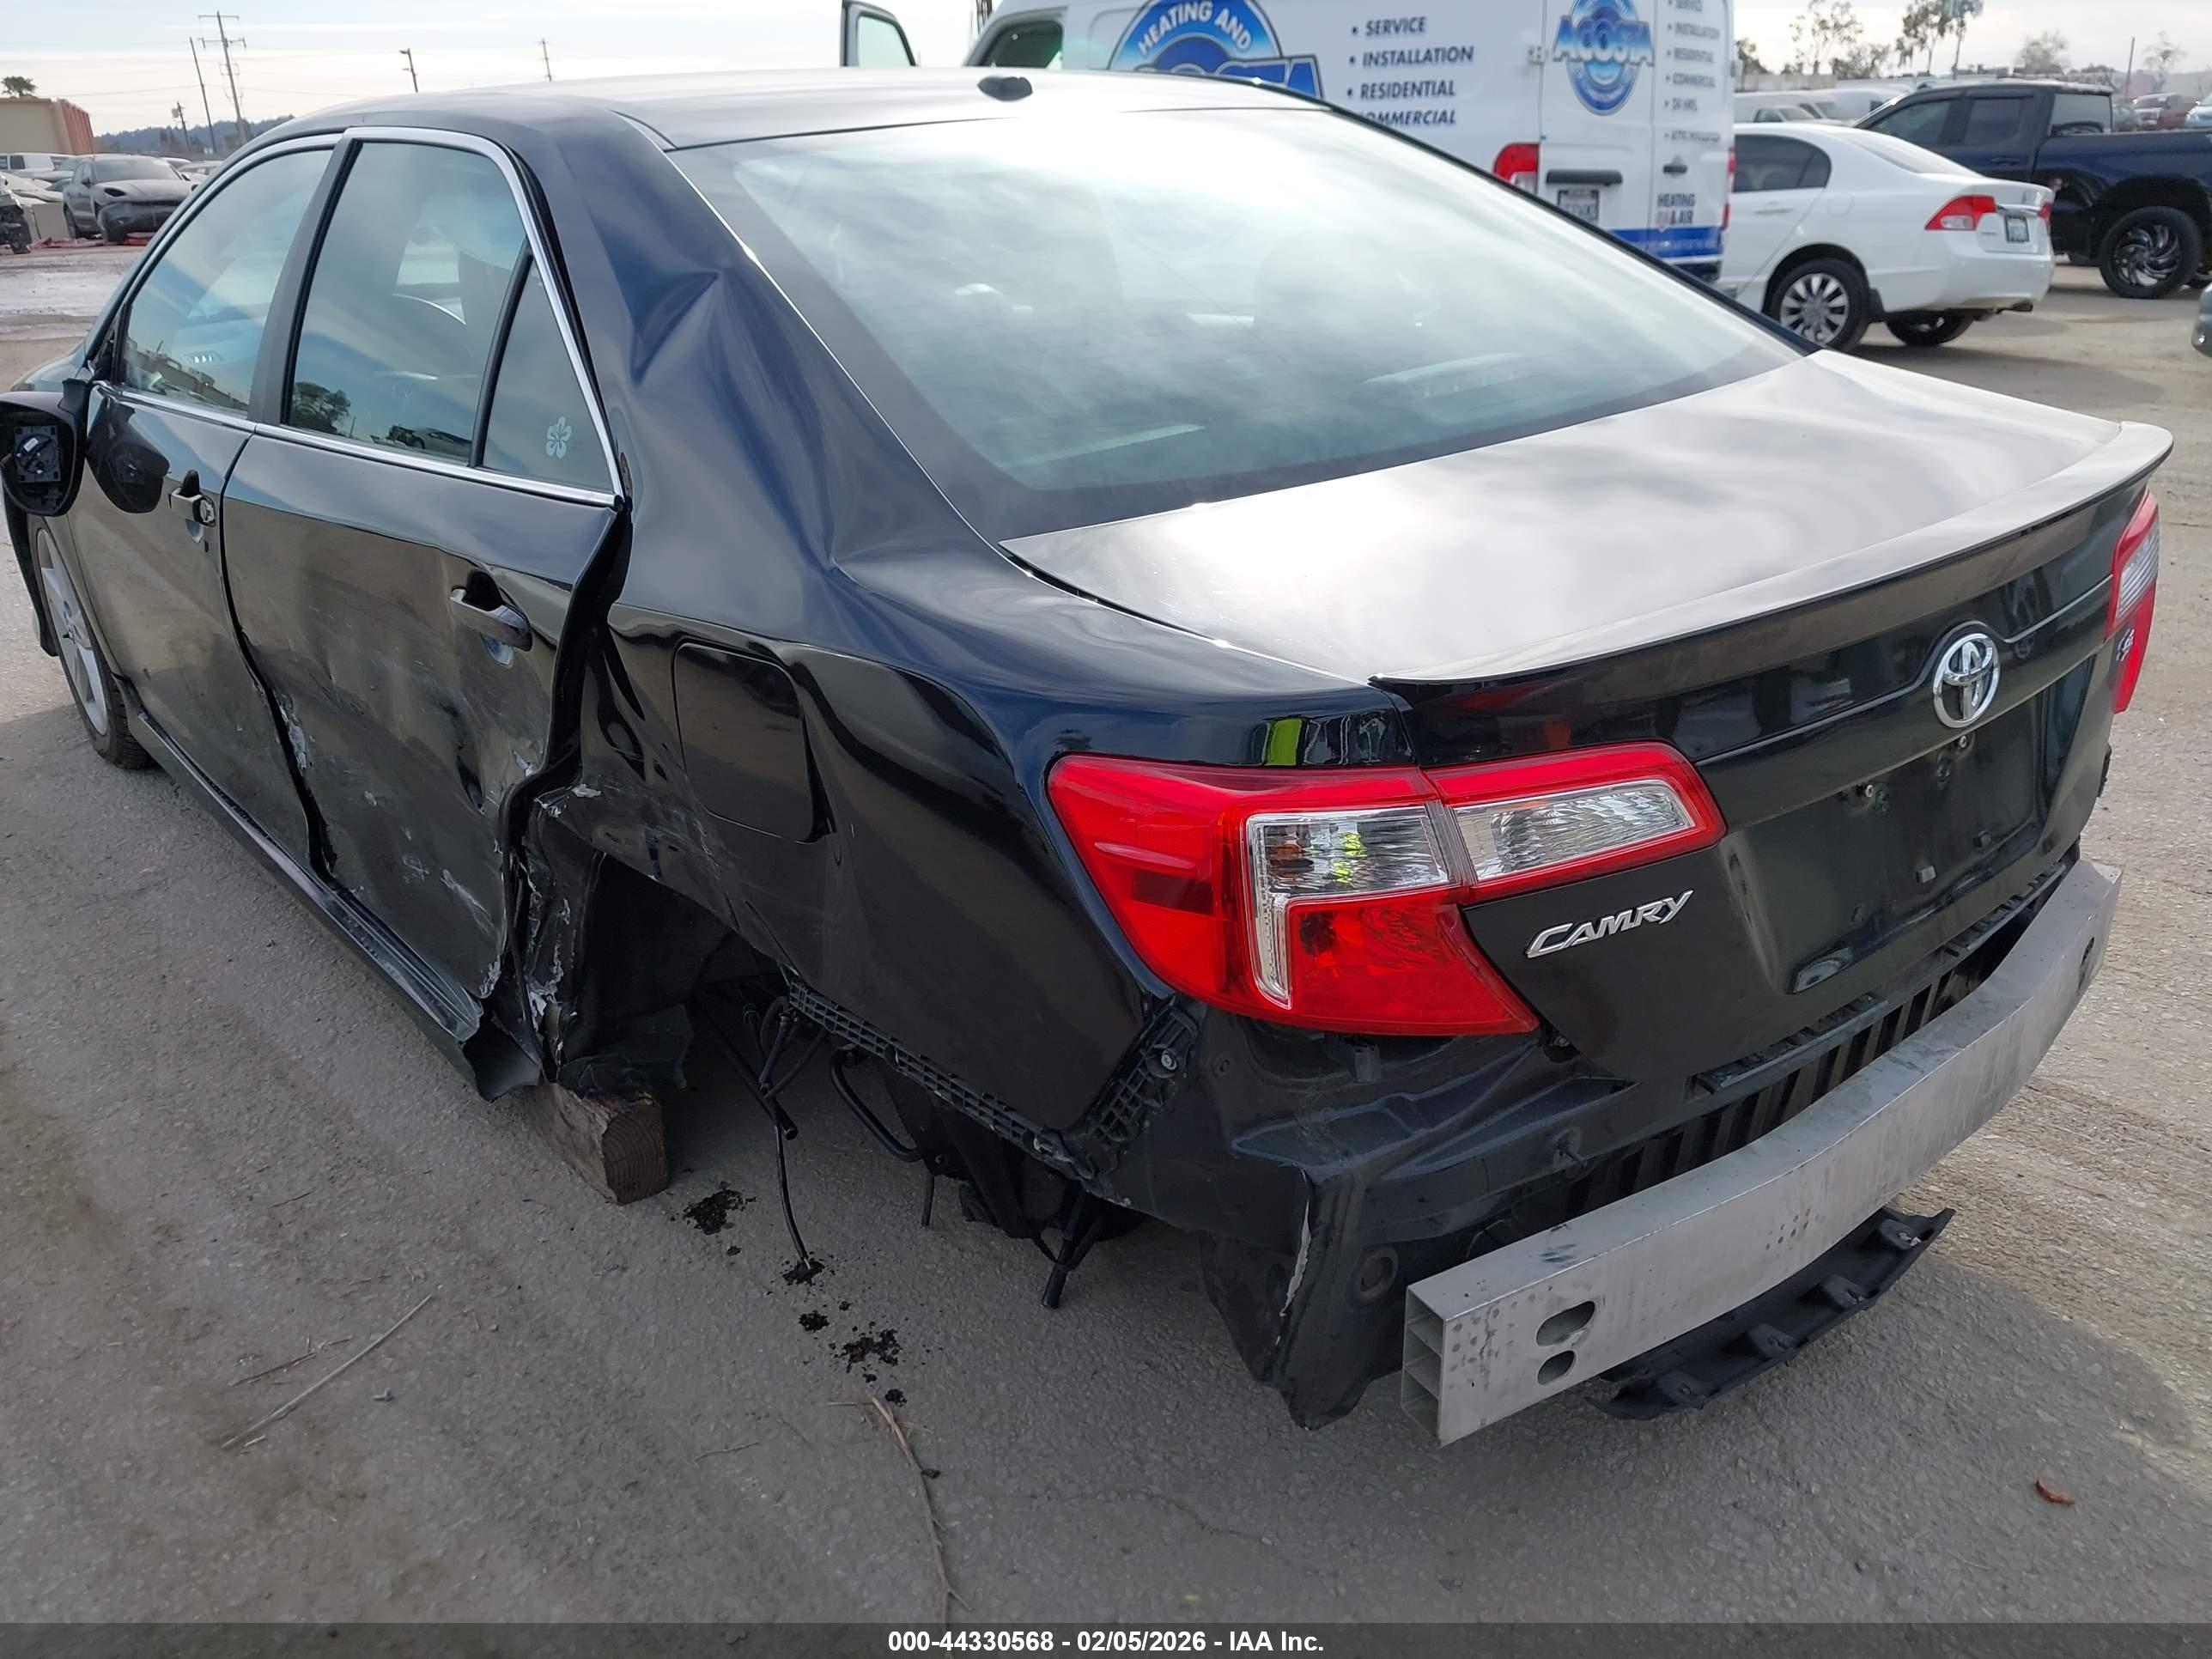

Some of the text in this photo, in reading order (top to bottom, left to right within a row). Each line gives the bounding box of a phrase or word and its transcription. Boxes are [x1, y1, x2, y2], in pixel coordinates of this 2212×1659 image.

[1138, 1, 1252, 54] HEATING AND
[1365, 16, 1426, 36] SERVICE
[1363, 46, 1474, 67] INSTALLATION
[1360, 80, 1455, 100] RESIDENTIAL
[1360, 110, 1456, 125] OMMERCIAL
[1657, 193, 1696, 207] HEATING
[1525, 889, 1694, 958] CAMRY
